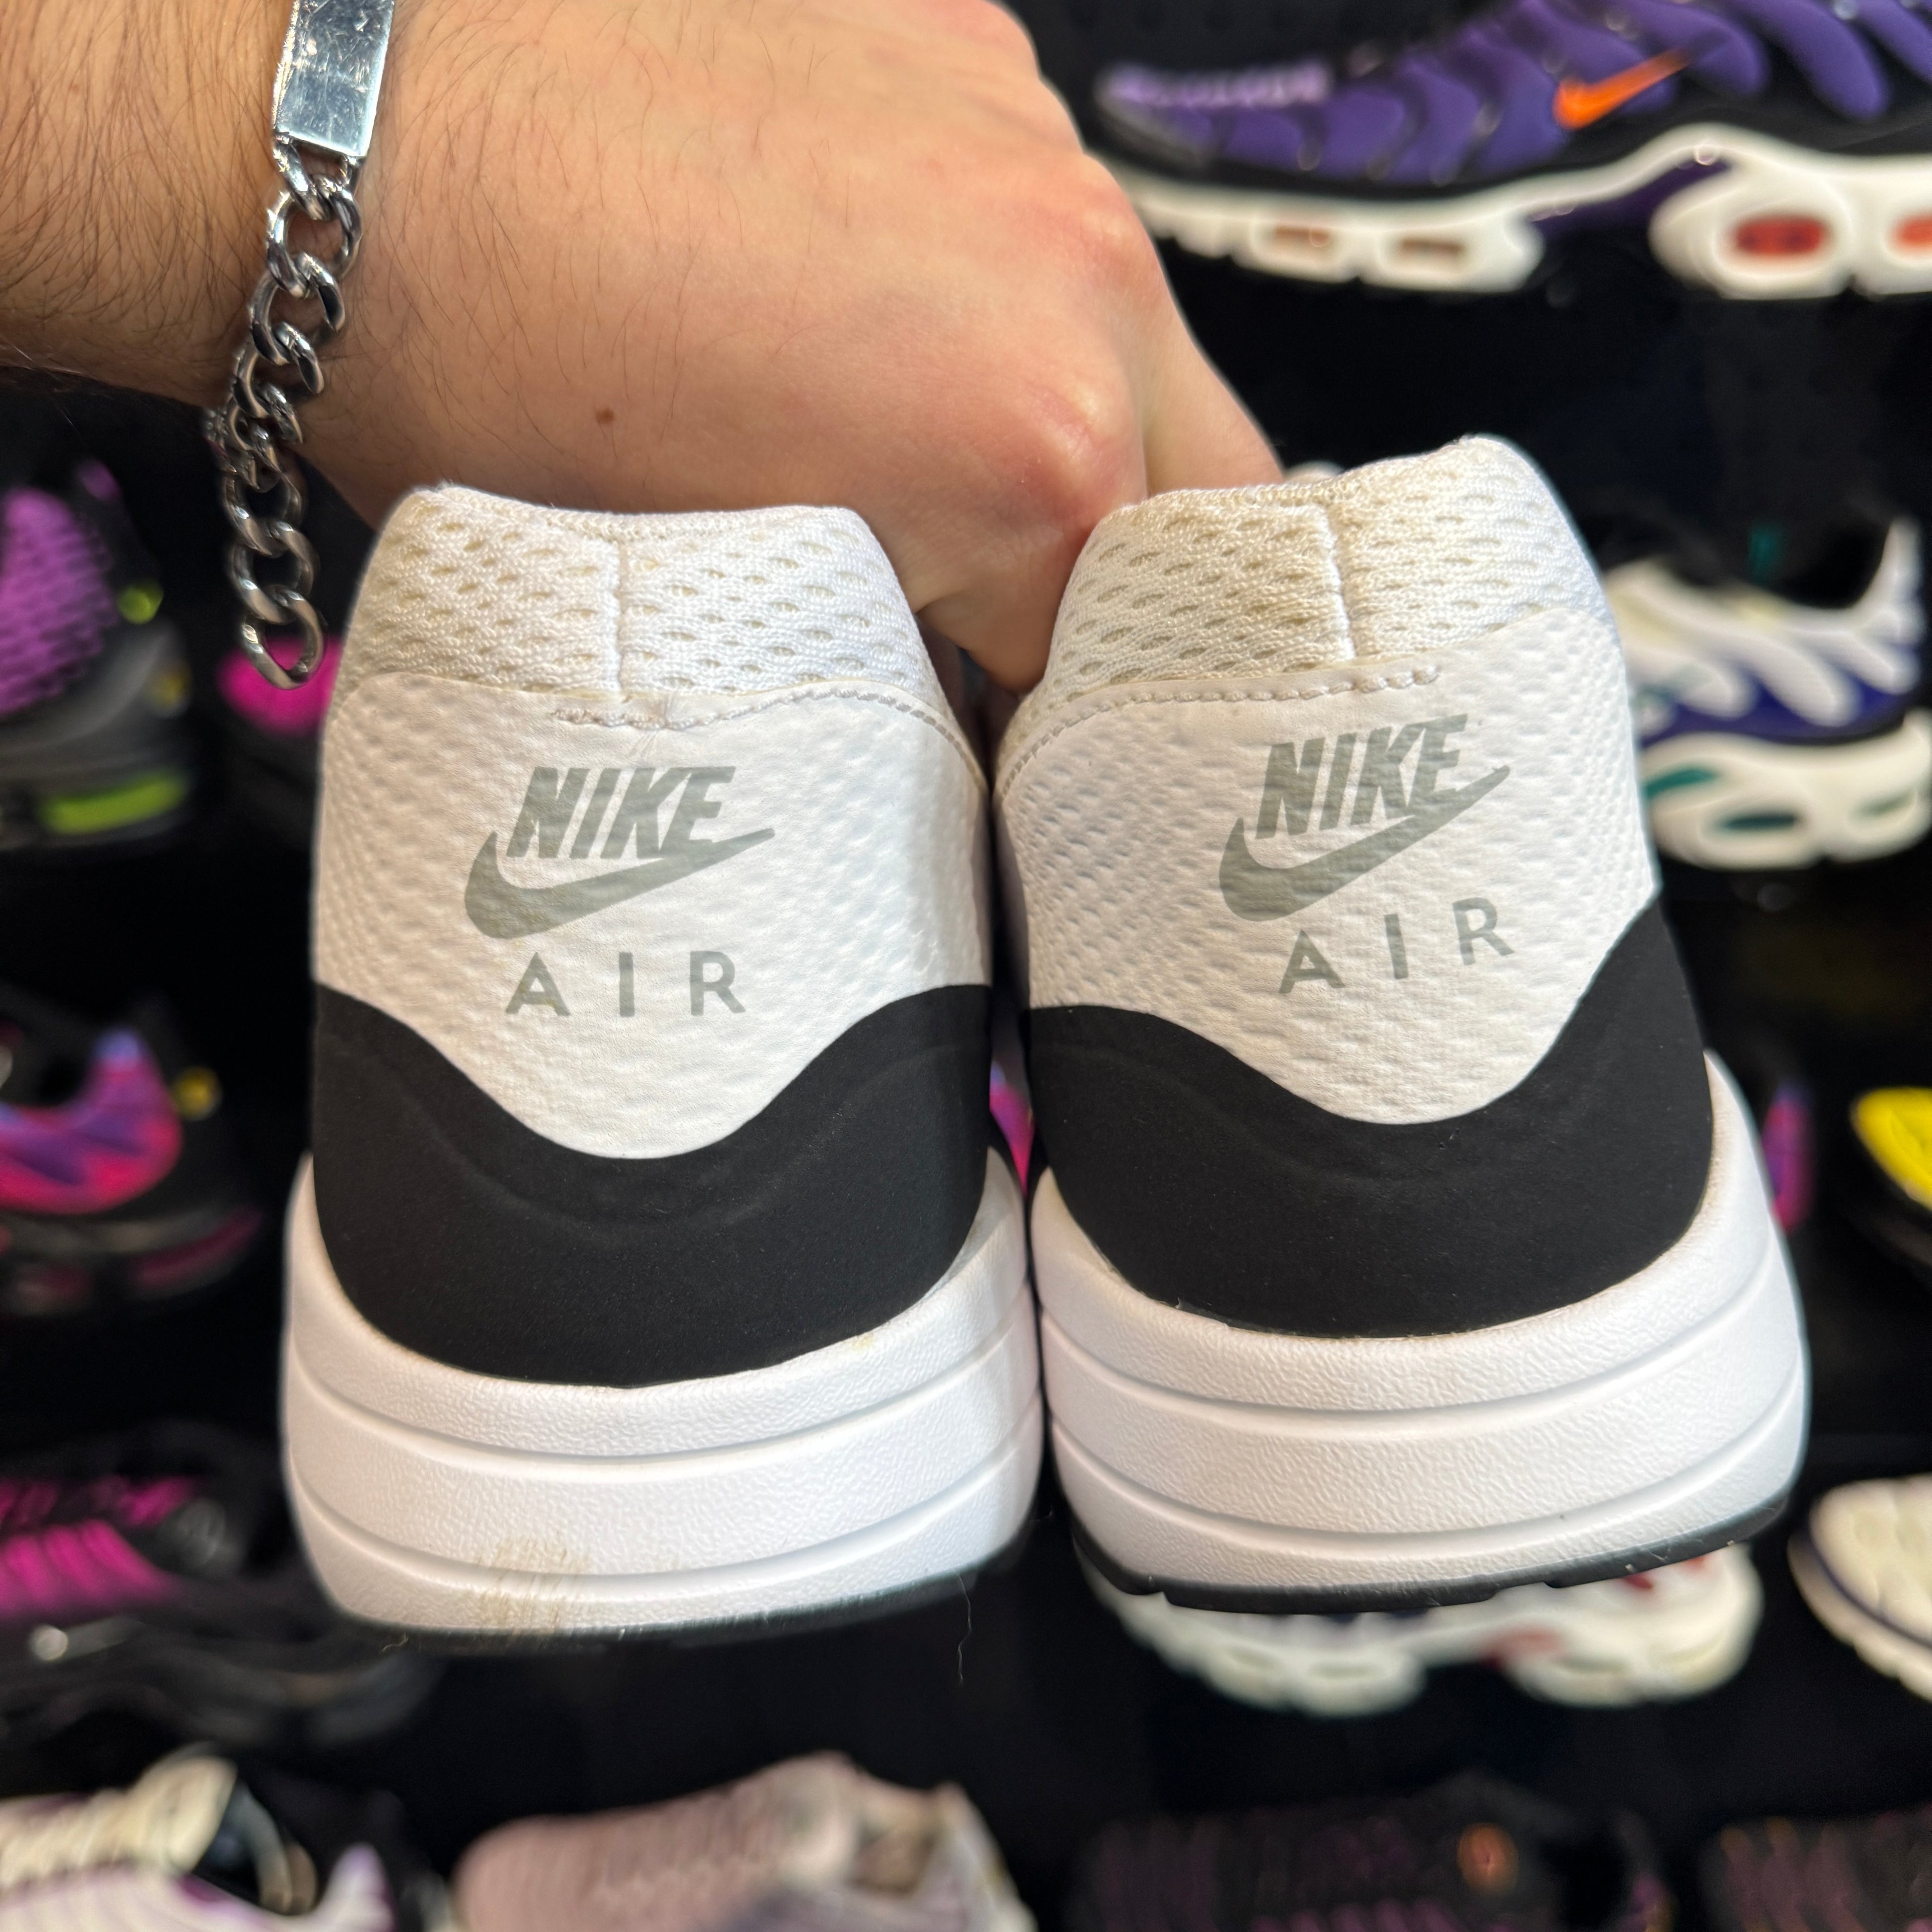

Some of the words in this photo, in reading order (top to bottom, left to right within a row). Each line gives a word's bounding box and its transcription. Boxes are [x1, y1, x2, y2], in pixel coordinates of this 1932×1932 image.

[506, 766, 736, 859] NIKE
[1255, 713, 1468, 840] NIKE
[505, 951, 746, 1017] AIR
[1278, 897, 1515, 994] AIR
